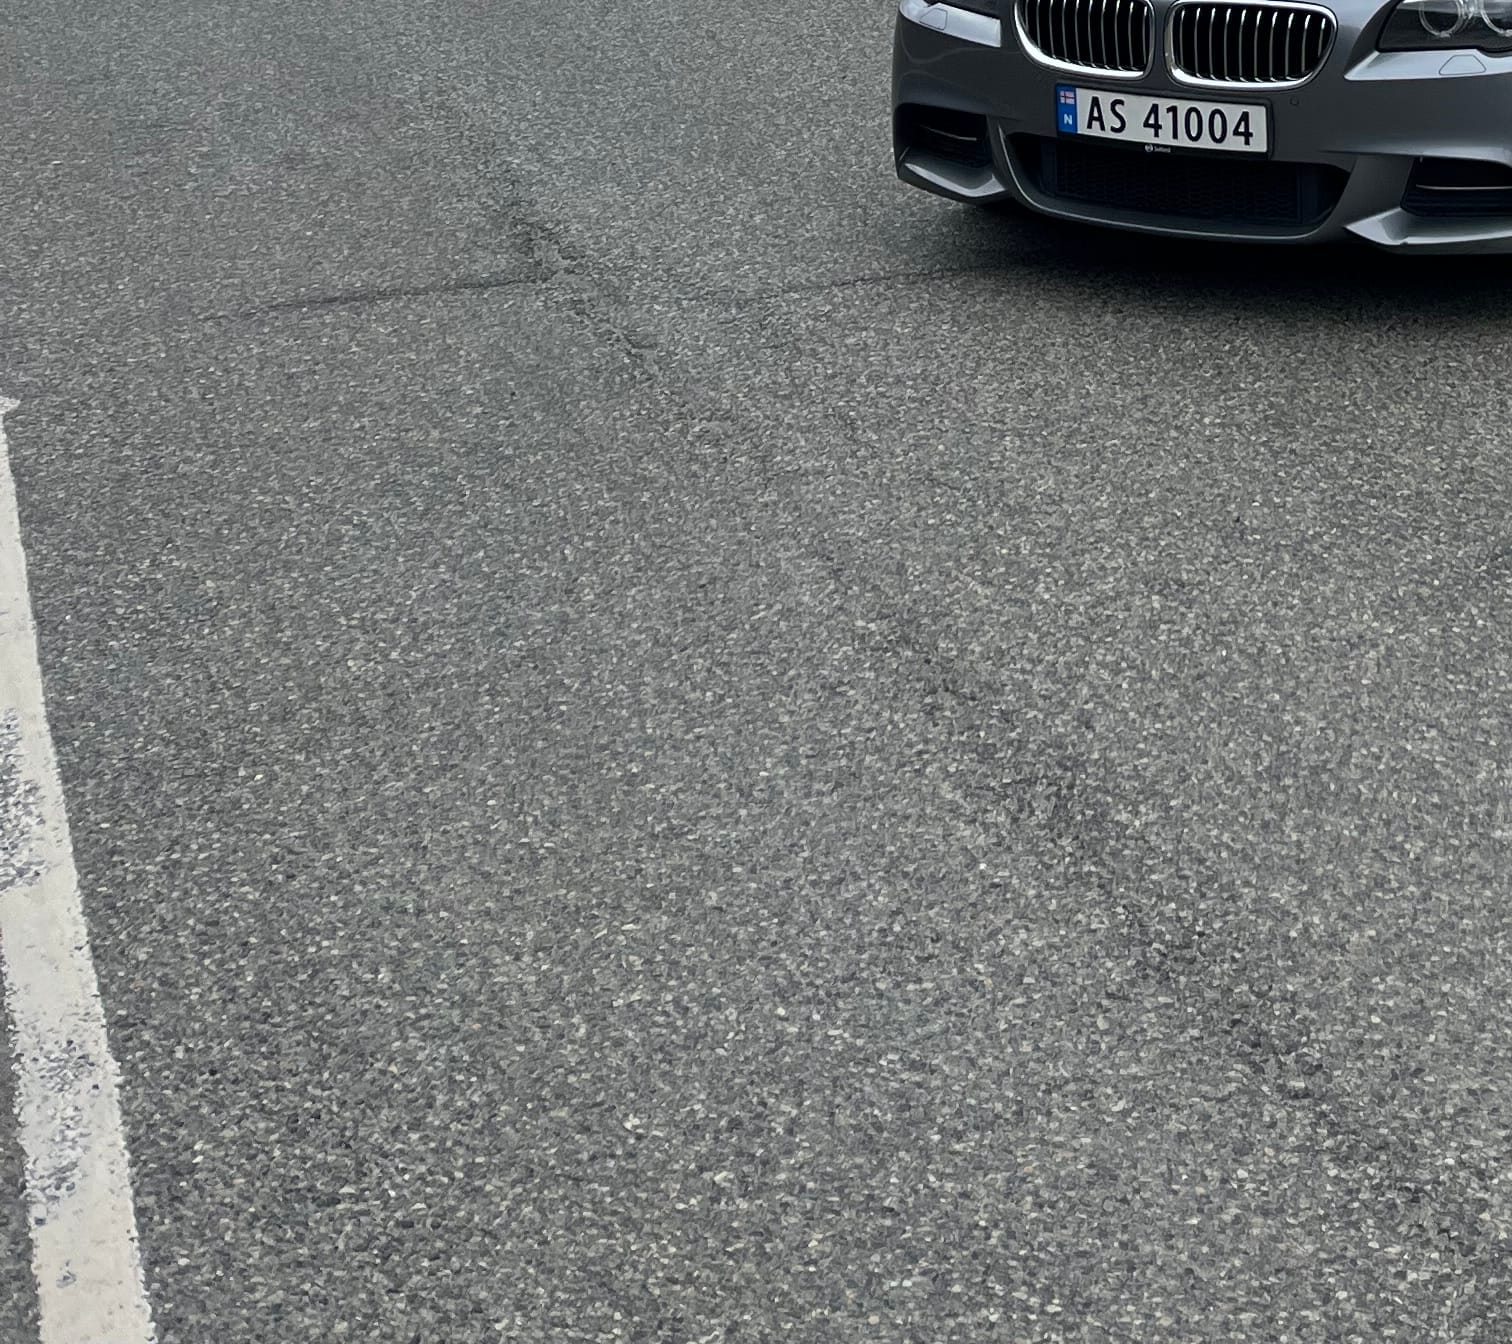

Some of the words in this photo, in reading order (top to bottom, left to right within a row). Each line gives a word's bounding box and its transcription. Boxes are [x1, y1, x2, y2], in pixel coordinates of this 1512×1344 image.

[1063, 113, 1073, 126] N
[1086, 95, 1127, 133] AS
[1143, 103, 1254, 146] 41004
